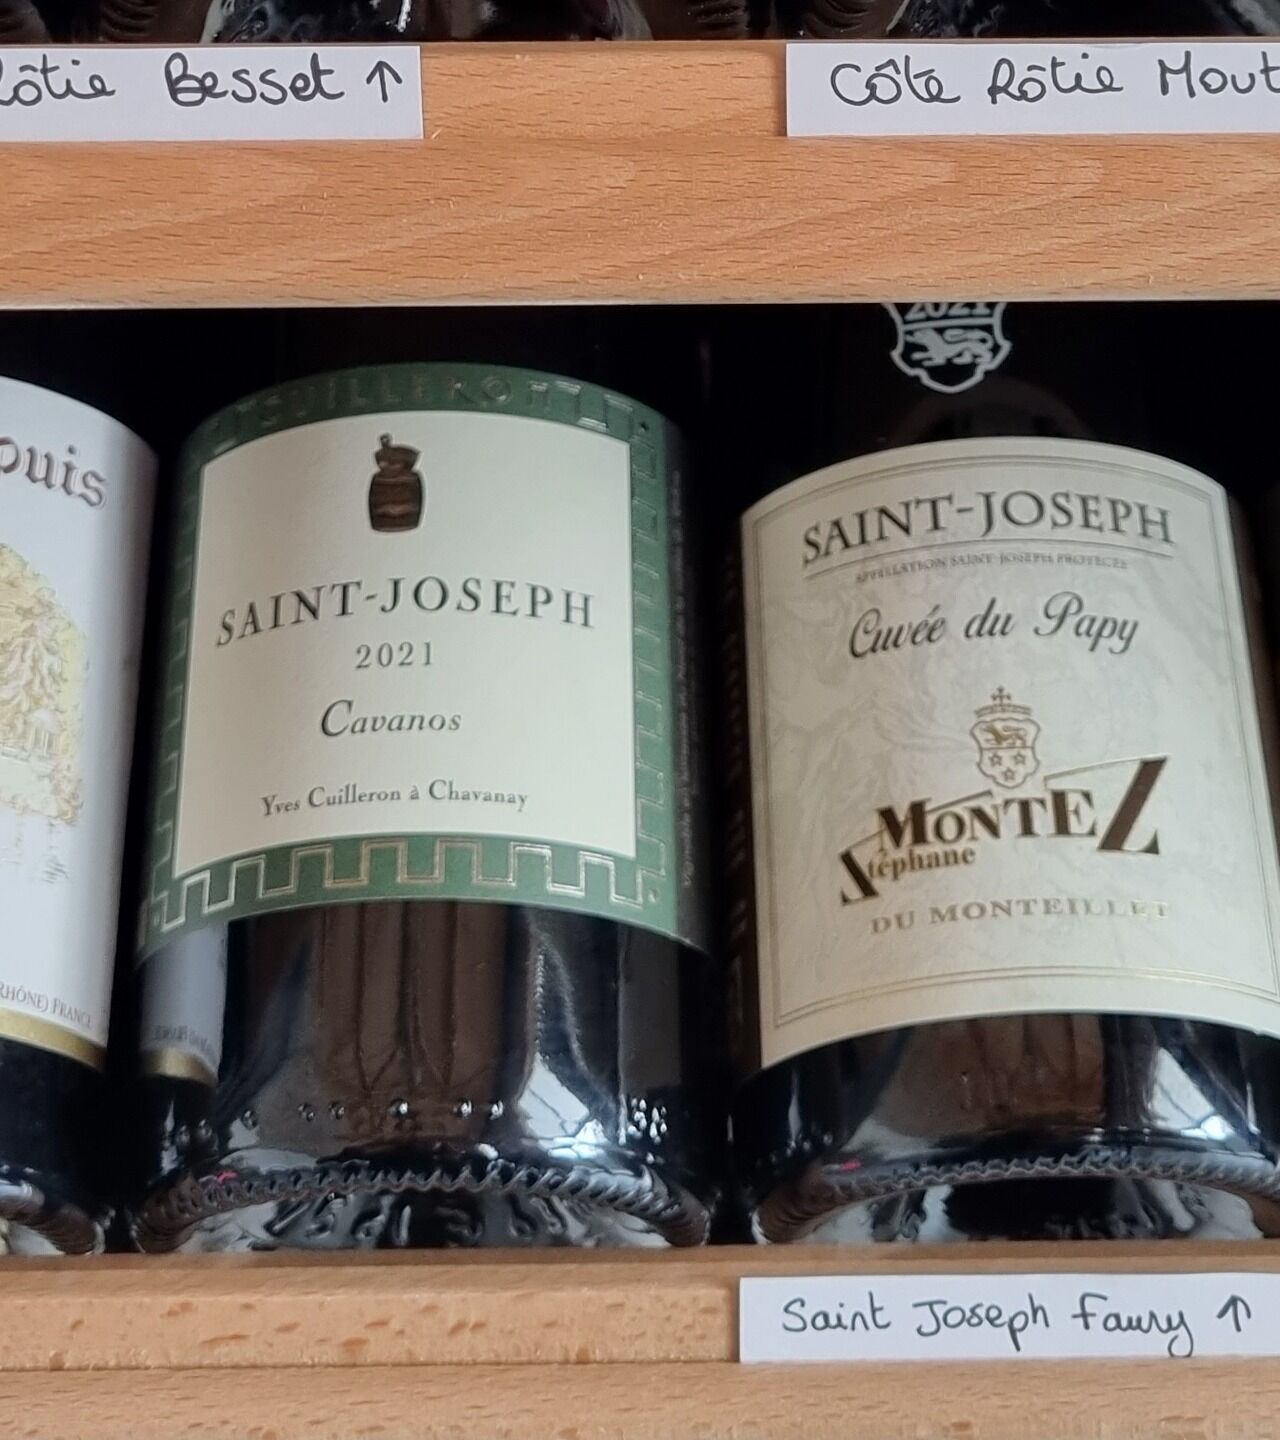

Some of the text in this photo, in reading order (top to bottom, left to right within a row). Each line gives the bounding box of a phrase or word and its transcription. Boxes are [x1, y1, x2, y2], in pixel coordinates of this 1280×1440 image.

[163, 50, 346, 108] Besset
[830, 55, 961, 107] Côte
[986, 51, 1124, 106] Rôtie
[802, 489, 1176, 568] SAINT-JOSEPH
[215, 576, 596, 648] SAINT-JOSEPH
[849, 590, 1141, 659] Cuvée du Papy
[355, 641, 435, 670] 2021
[320, 698, 463, 738] Cavanos
[260, 779, 529, 817] Yves Cuilleron à Chavanay
[870, 910, 916, 935] DU
[781, 1291, 892, 1334] Saint
[912, 1293, 1051, 1352] Joseph
